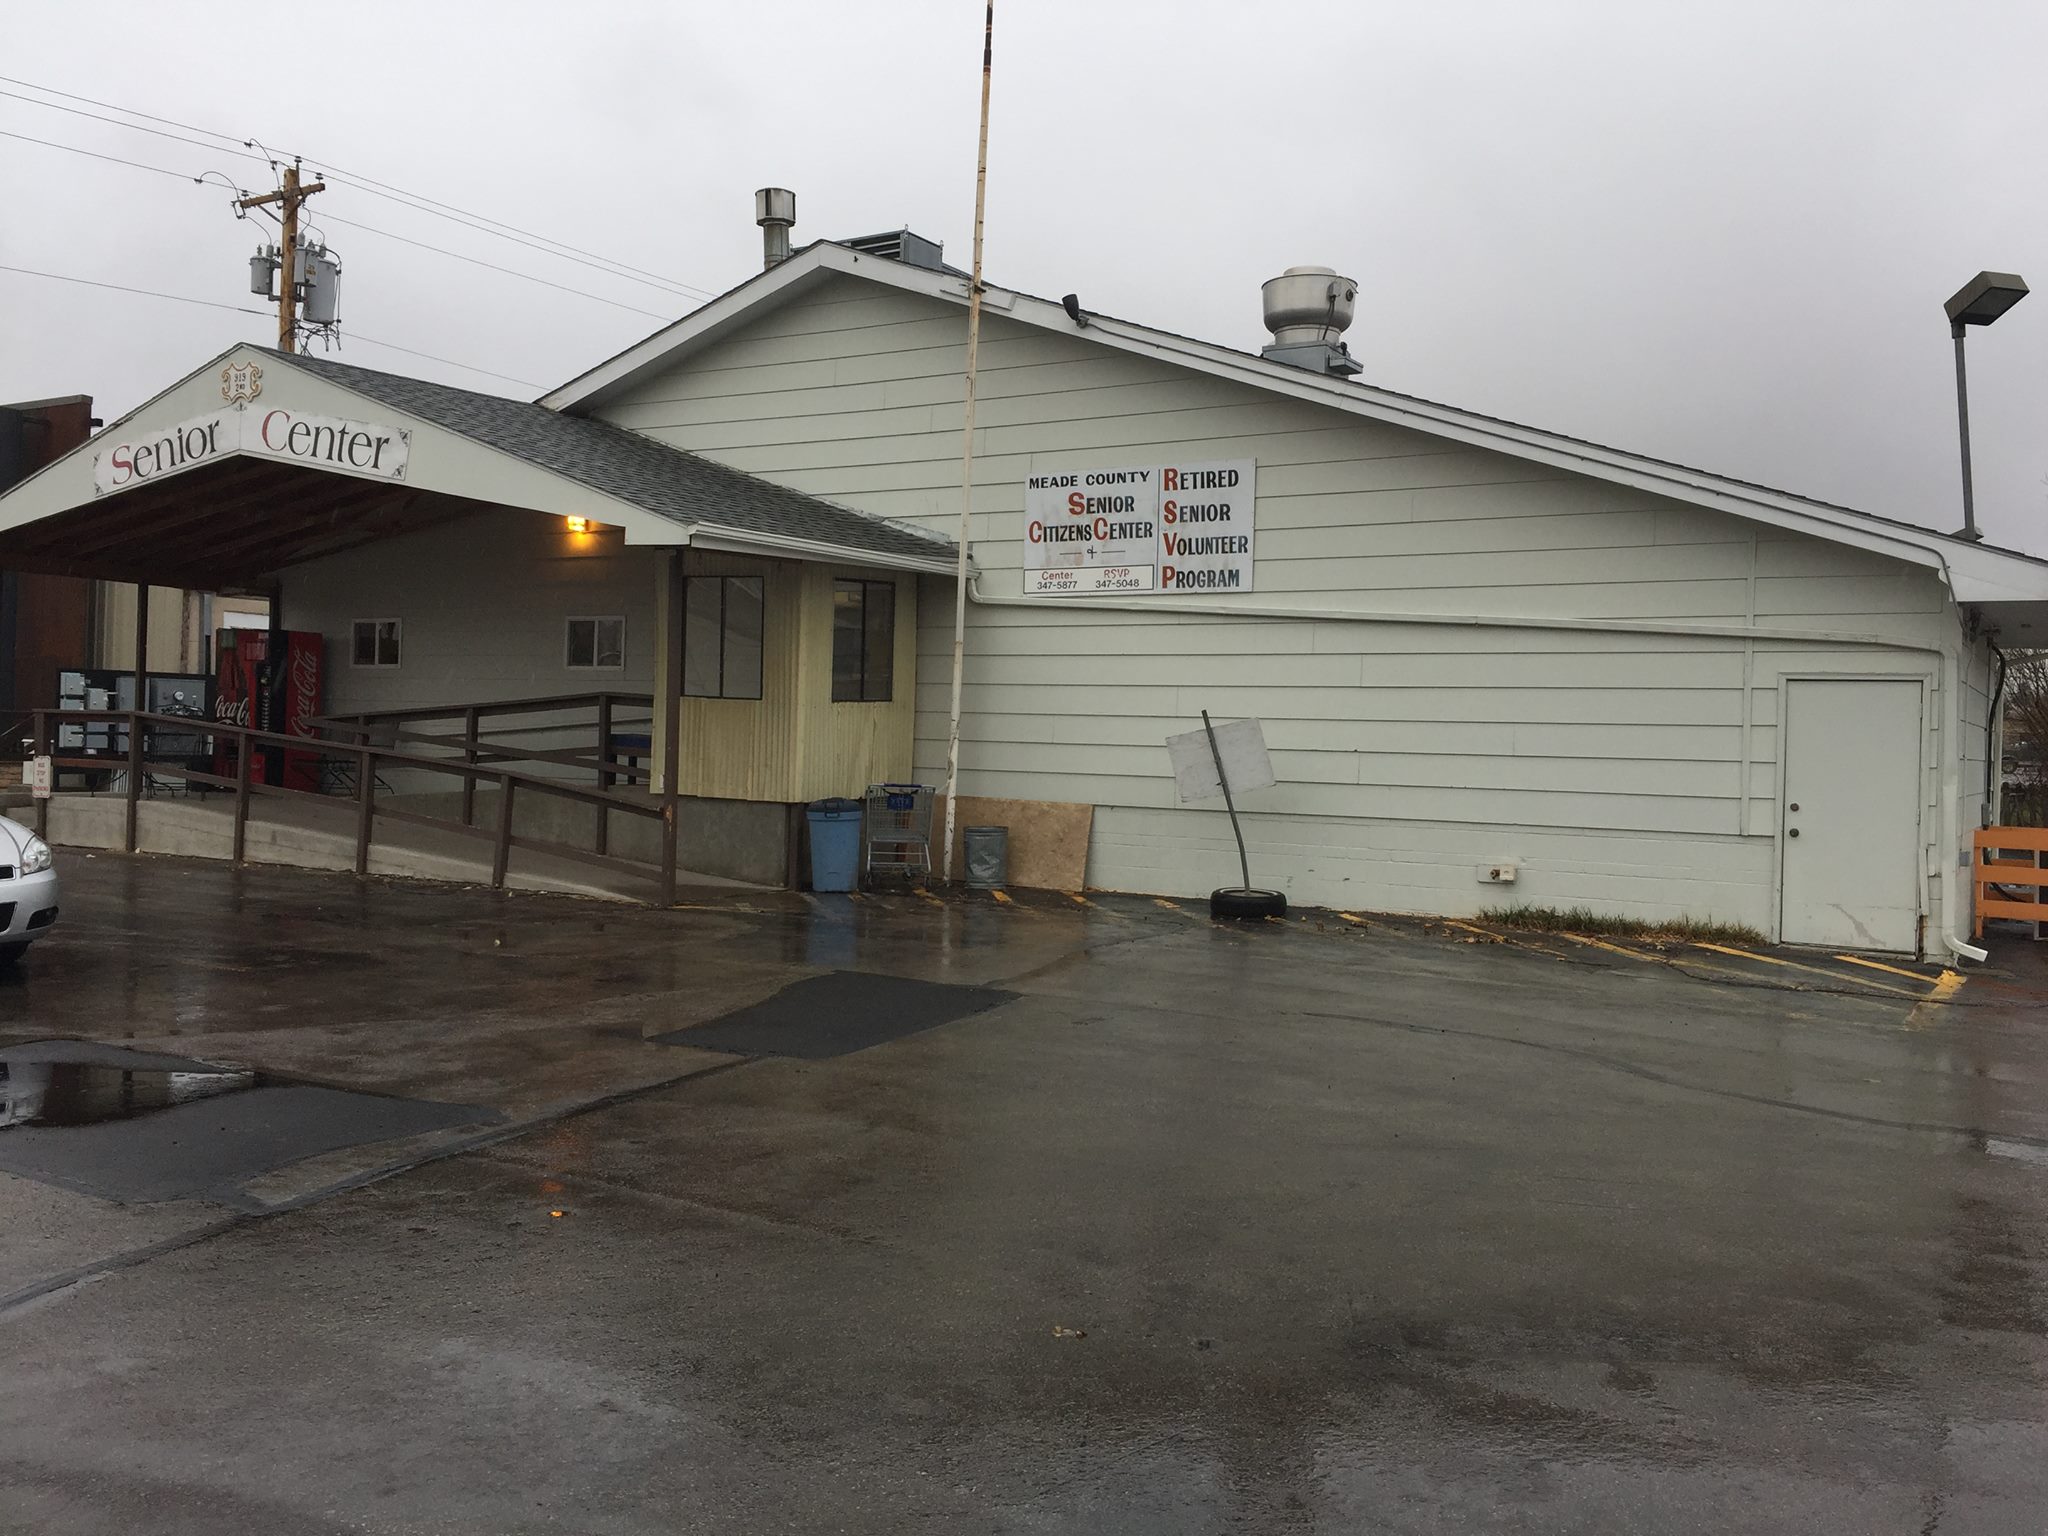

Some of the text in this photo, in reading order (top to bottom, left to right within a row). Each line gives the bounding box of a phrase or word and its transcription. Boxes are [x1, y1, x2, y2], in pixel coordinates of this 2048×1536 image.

[112, 410, 390, 485] Senior Center
[1029, 470, 1150, 489] MEADE COUNTY
[1164, 468, 1239, 491] RETIRED
[1068, 492, 1135, 515] SENIOR
[1164, 500, 1231, 524] SENIOR
[1029, 517, 1153, 543] CITIZENS CENTER
[1163, 532, 1248, 556] VOLUNTEER
[1041, 571, 1073, 581] Center
[1095, 579, 1140, 588] 347-5048
[1103, 568, 1130, 579] RSVP
[1162, 566, 1240, 589] PROGRAM
[1037, 581, 1077, 590] 347-5877
